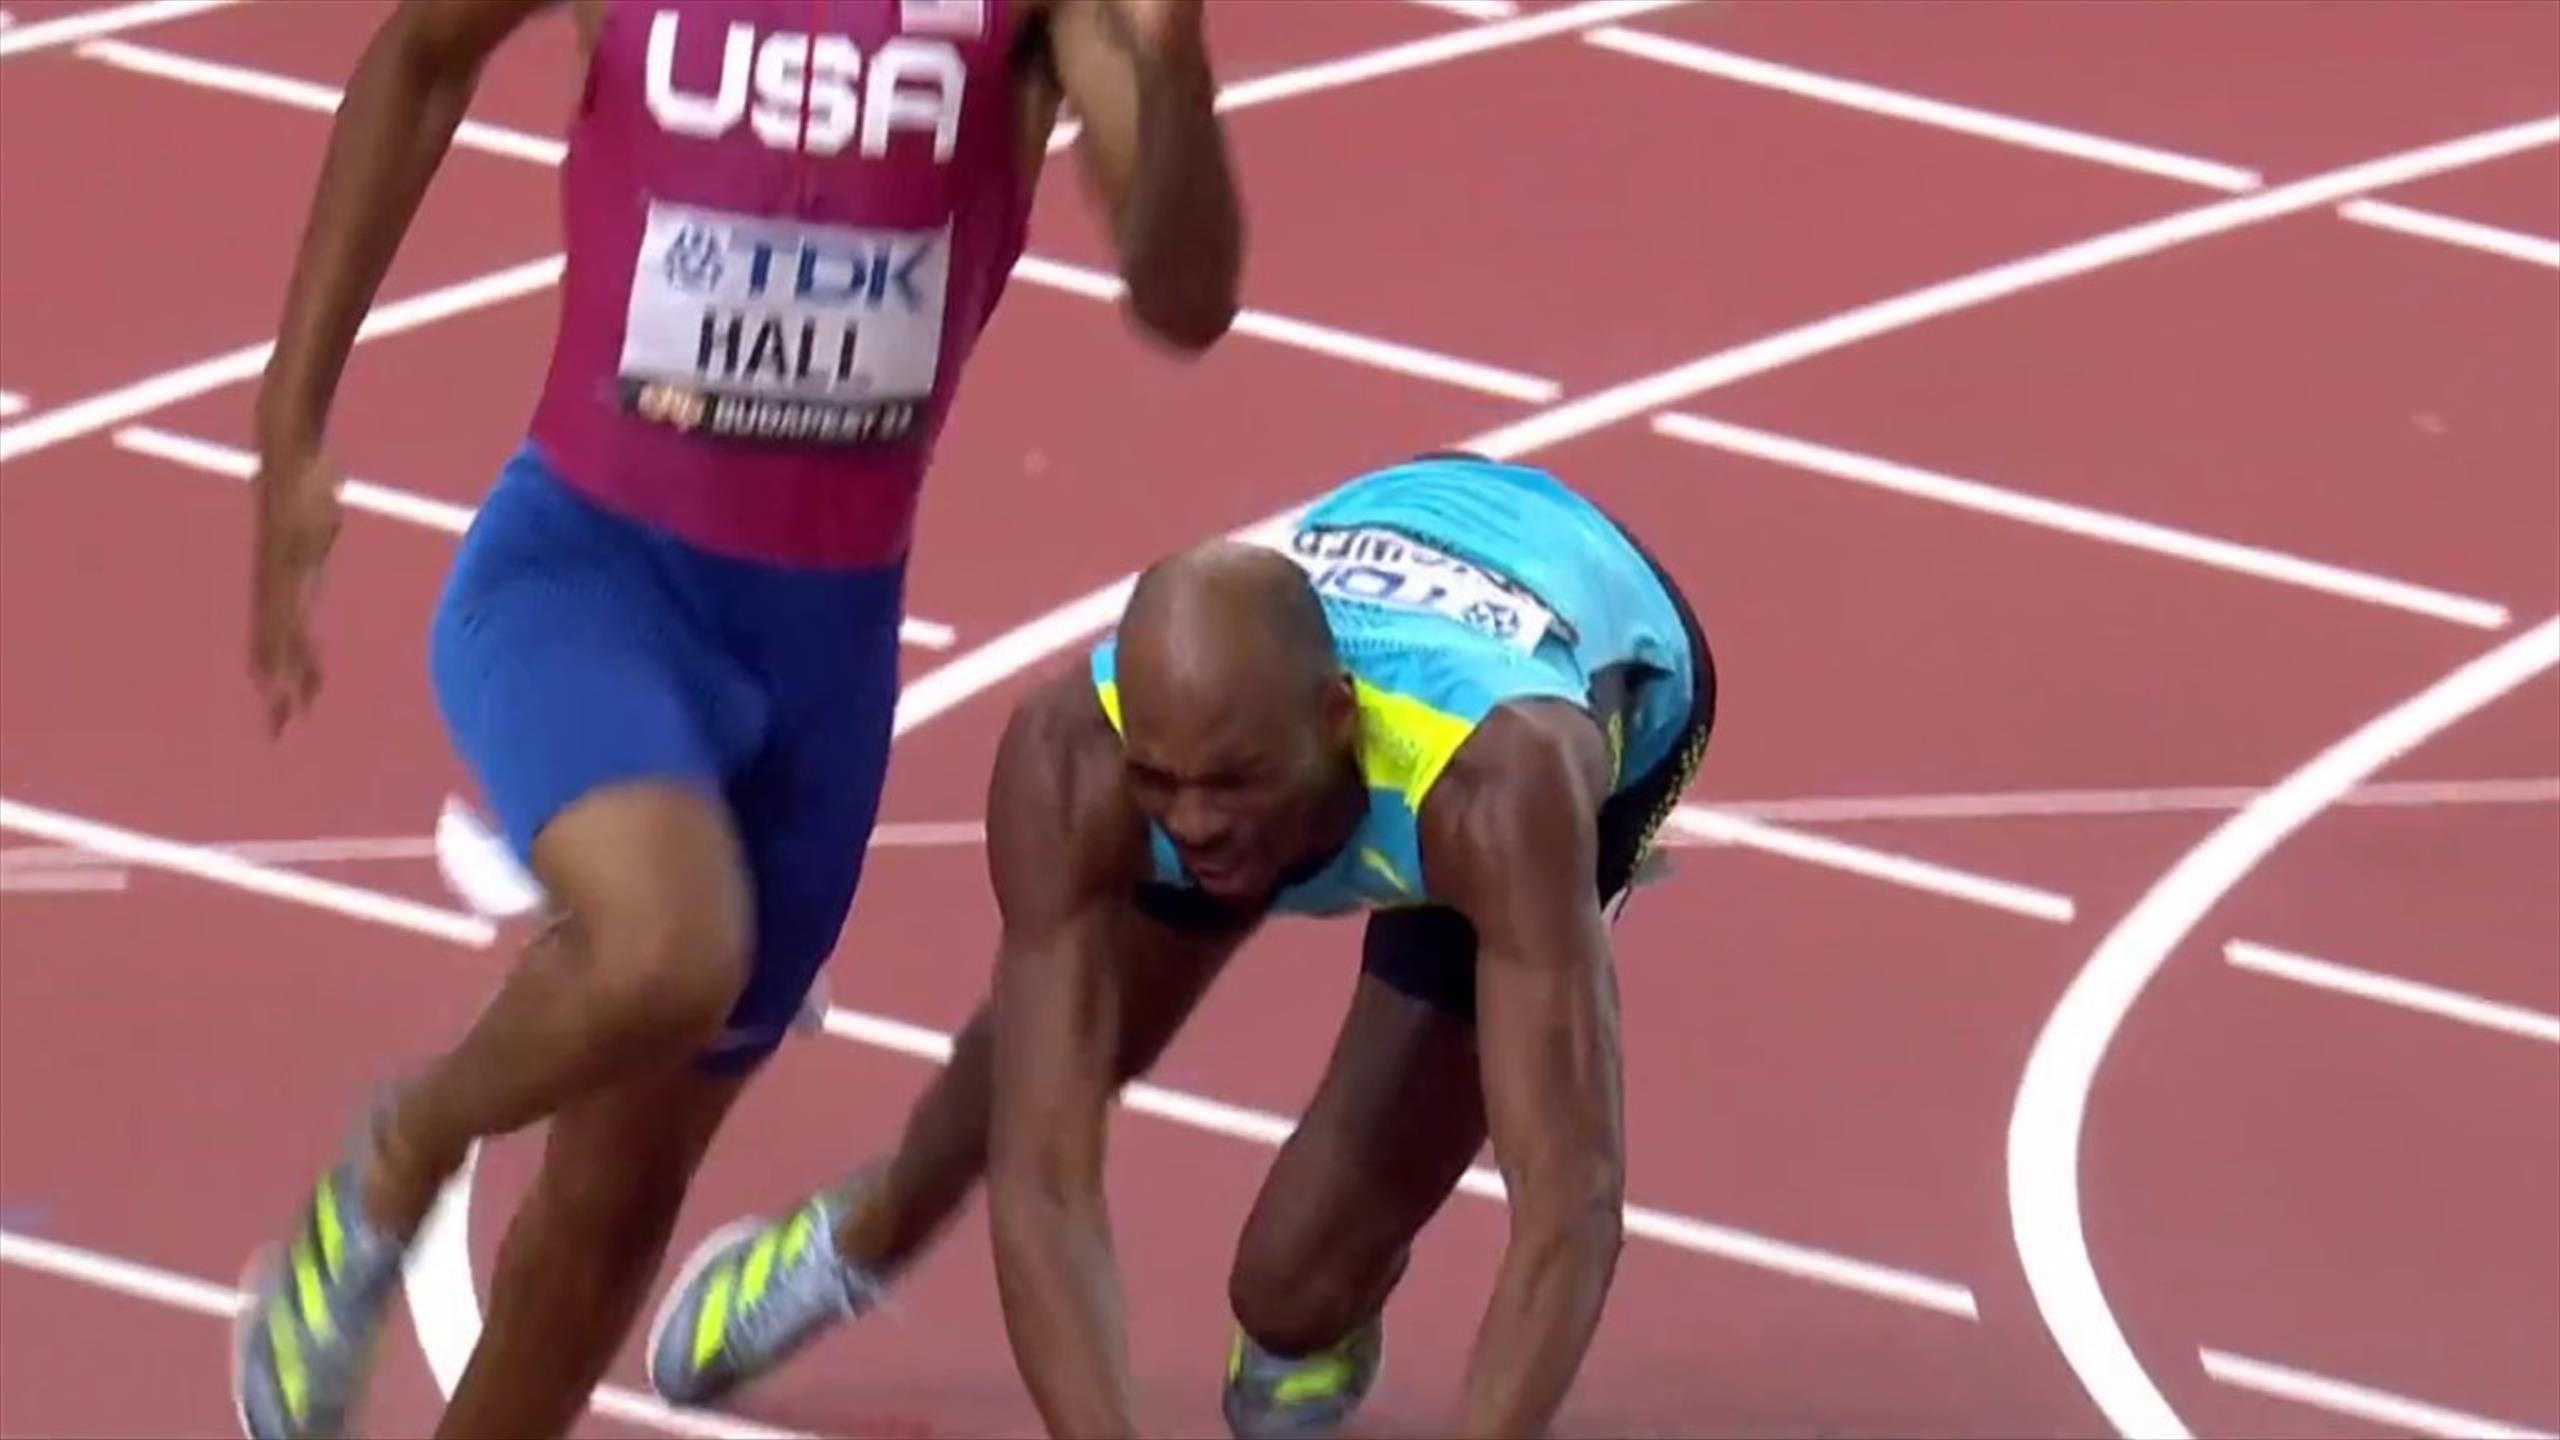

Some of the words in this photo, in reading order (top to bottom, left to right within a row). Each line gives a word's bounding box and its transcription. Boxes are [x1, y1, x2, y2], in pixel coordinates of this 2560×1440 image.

[645, 10, 967, 163] USA
[727, 228, 932, 314] TDK
[697, 306, 872, 391] HALL
